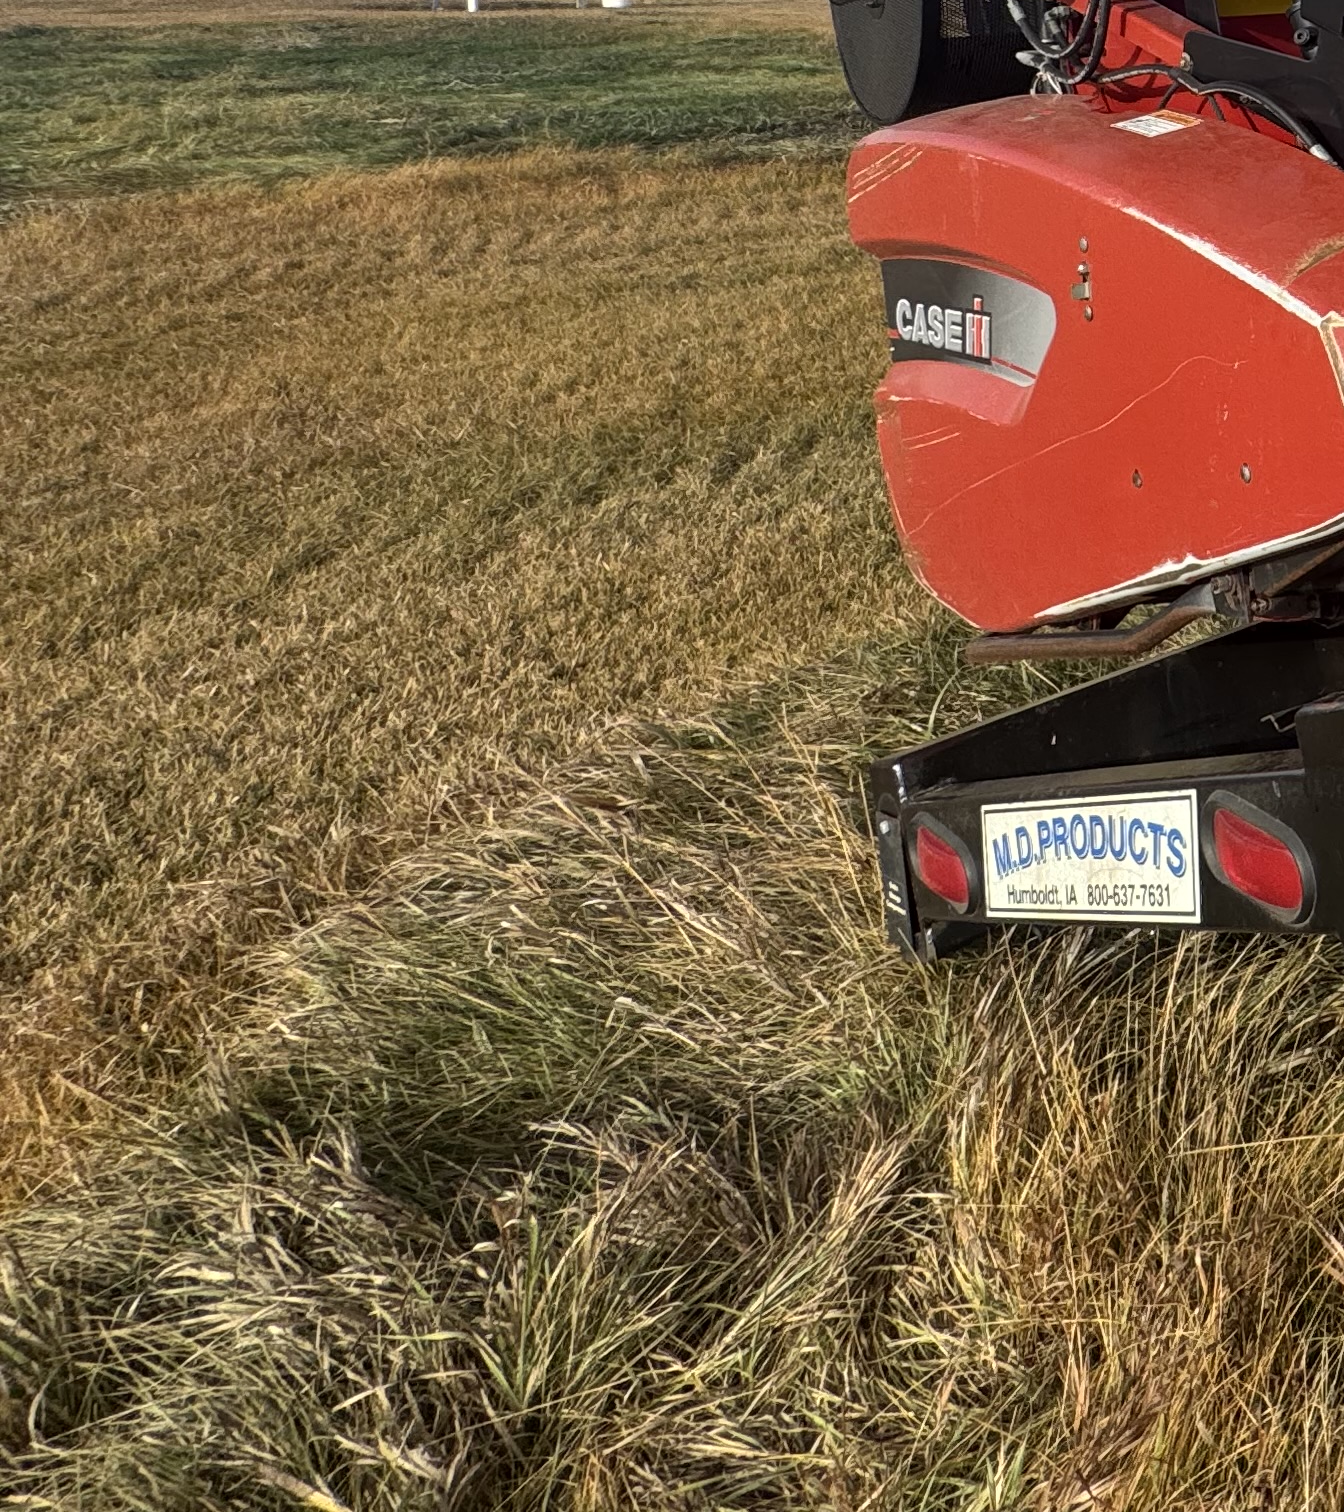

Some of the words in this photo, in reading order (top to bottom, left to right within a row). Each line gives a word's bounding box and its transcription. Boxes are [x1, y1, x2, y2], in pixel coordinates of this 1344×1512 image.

[896, 298, 963, 353] CASE
[1007, 884, 1063, 909] Humboldt,
[1065, 884, 1078, 905] IA
[1087, 883, 1171, 907] 800-637-7631
